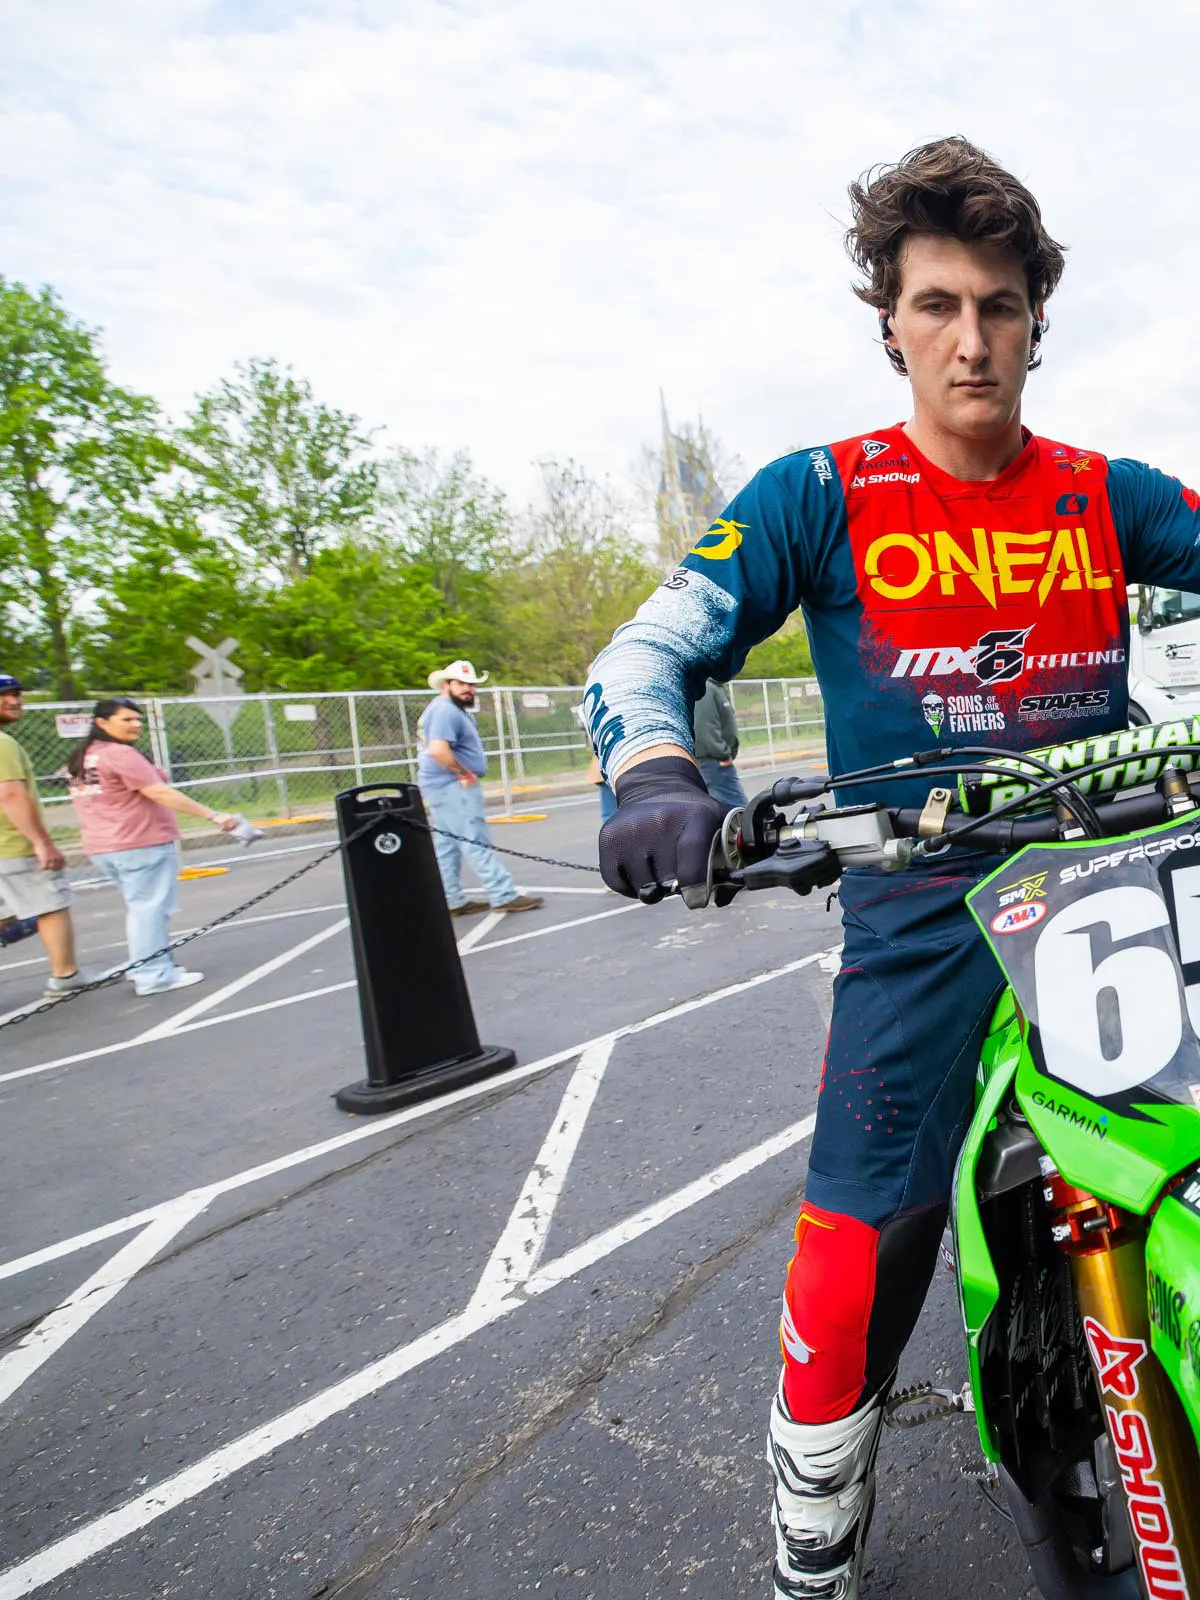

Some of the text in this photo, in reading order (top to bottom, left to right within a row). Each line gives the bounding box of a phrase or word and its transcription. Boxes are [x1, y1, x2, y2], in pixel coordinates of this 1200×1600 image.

[858, 459, 911, 471] GARMIN
[868, 472, 921, 484] SHOWA
[1026, 648, 1126, 671] RACING
[948, 694, 984, 714] SONS
[1018, 690, 1110, 713] STAPES
[950, 711, 1006, 733] FATHERS
[1018, 706, 1110, 722] PERFORMANCE
[1001, 905, 1038, 930] AMA
[1032, 1091, 1108, 1140] GARMIN
